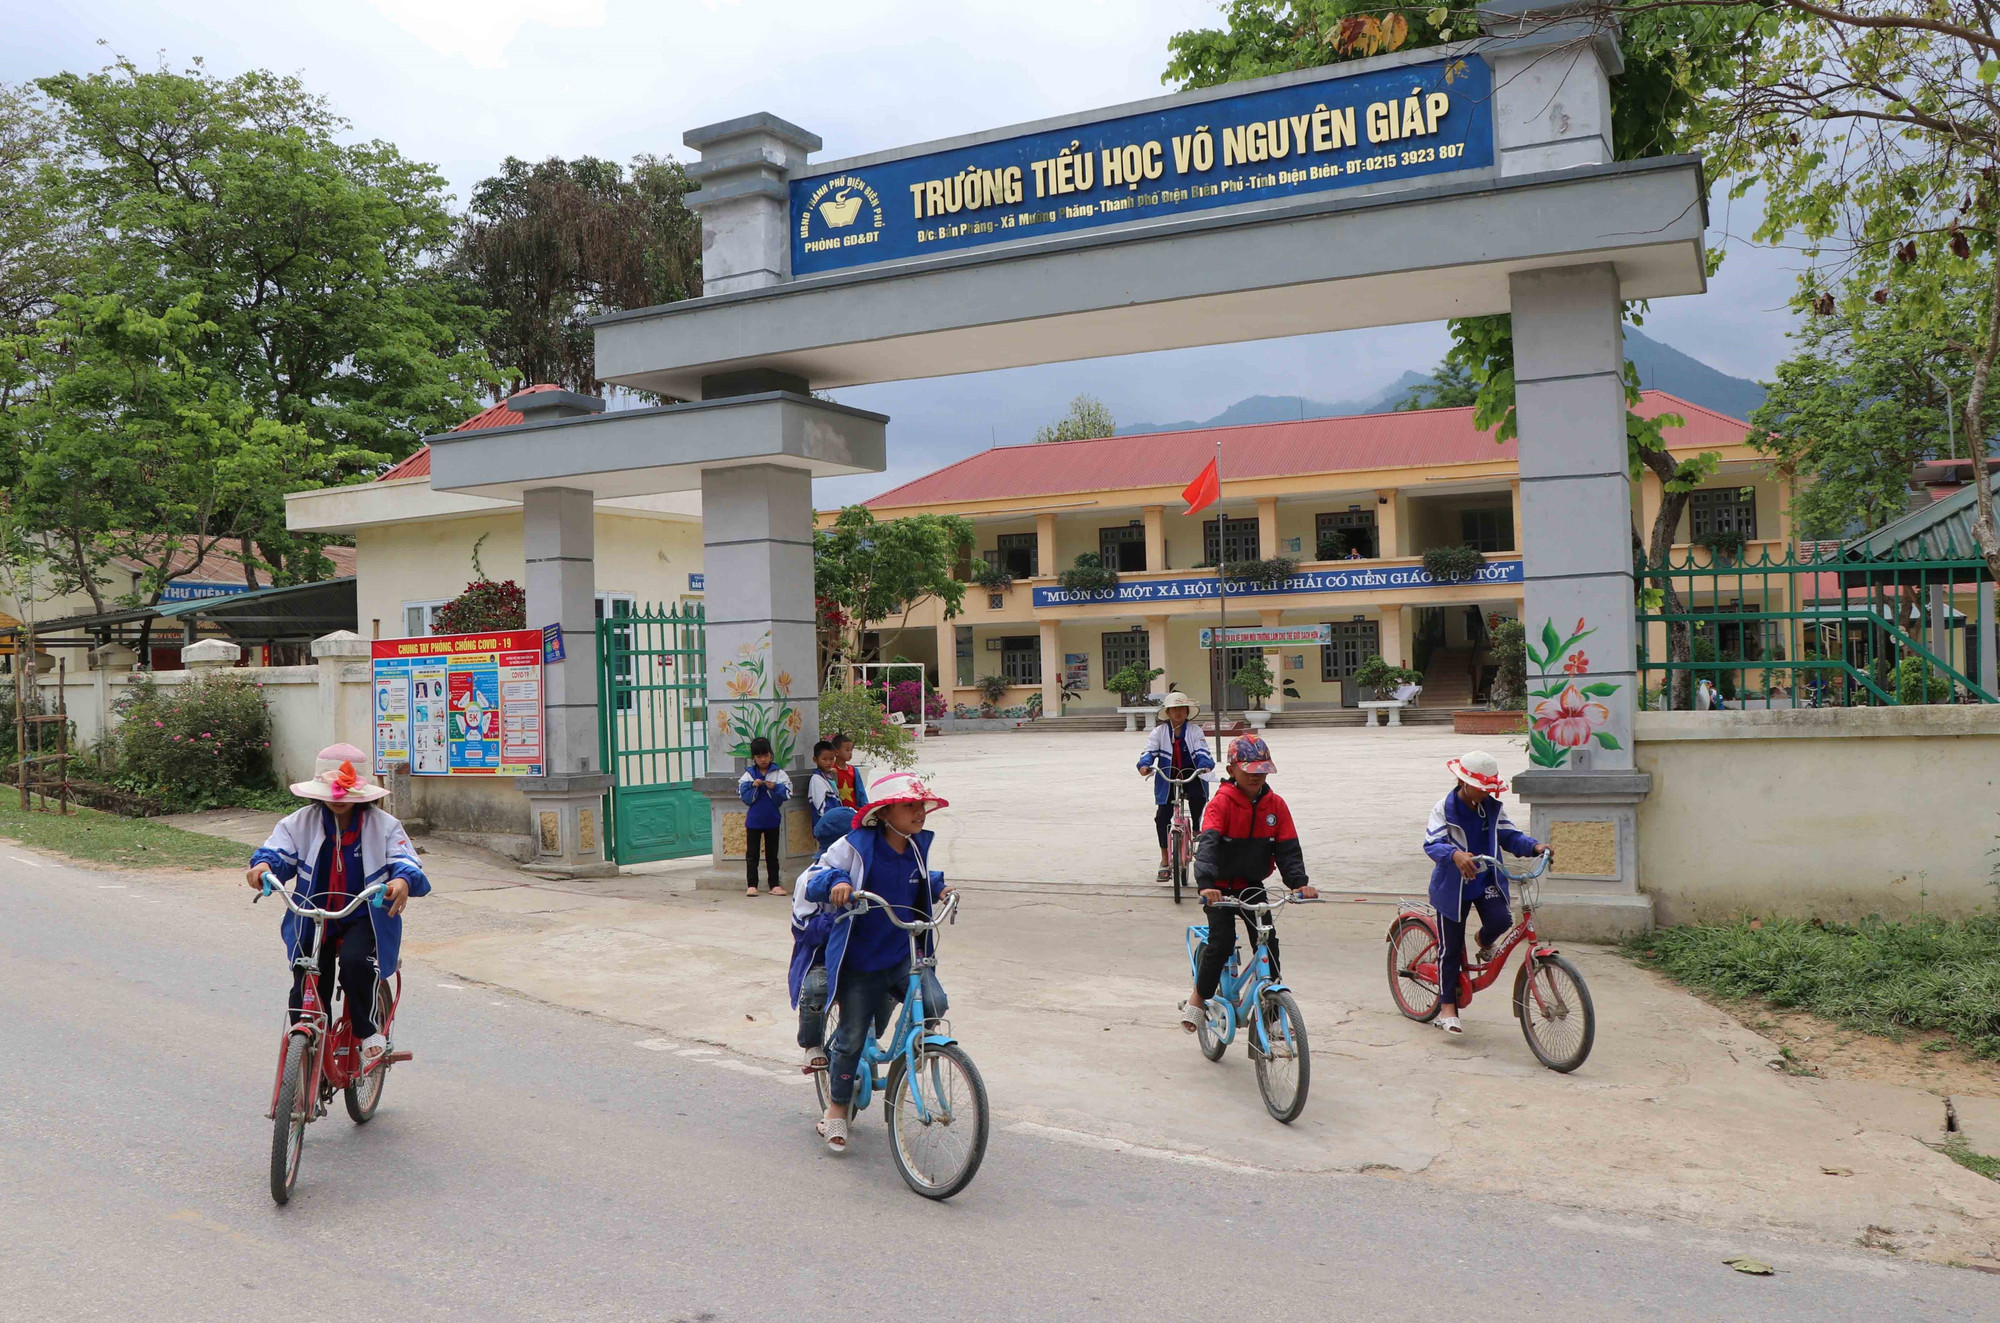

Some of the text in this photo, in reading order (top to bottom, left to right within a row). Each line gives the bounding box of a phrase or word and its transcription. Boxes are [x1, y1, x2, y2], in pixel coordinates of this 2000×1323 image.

[910, 87, 1449, 219] TRƯỜNG TIỂU HỌC VÕ NGUYÊN GIÁP
[939, 224, 958, 239] Bản
[1001, 214, 1014, 228] Xã
[1019, 210, 1056, 226] Mường
[1137, 190, 1161, 207] Phố
[1162, 188, 1188, 205] Điện
[1192, 183, 1217, 198] Biên
[1279, 168, 1306, 186] Điện
[1401, 148, 1435, 165] 3923
[1439, 143, 1464, 159] 807
[800, 174, 885, 238] UBND THÀNH PHỐ ĐIỆN BIÊN PHỦ
[805, 231, 879, 253] PHÒNG GD&ĐT
[163, 587, 191, 598] THƯ
[1120, 583, 1152, 600] MỘT
[1157, 583, 1180, 596] XÃ
[1184, 581, 1212, 597] HỘI
[1283, 573, 1322, 589] PHẢI
[1326, 573, 1347, 587] CÓ
[1351, 570, 1387, 586] NỀN
[1390, 569, 1432, 584] GIÁO
[398, 644, 418, 654] CHUNG
[419, 644, 429, 653] TAY
[431, 640, 453, 653] PHÒNG,
[455, 637, 476, 651] CHỐNG
[478, 639, 496, 650] COVID
[503, 638, 511, 648] 19
[469, 714, 478, 722] 5K
